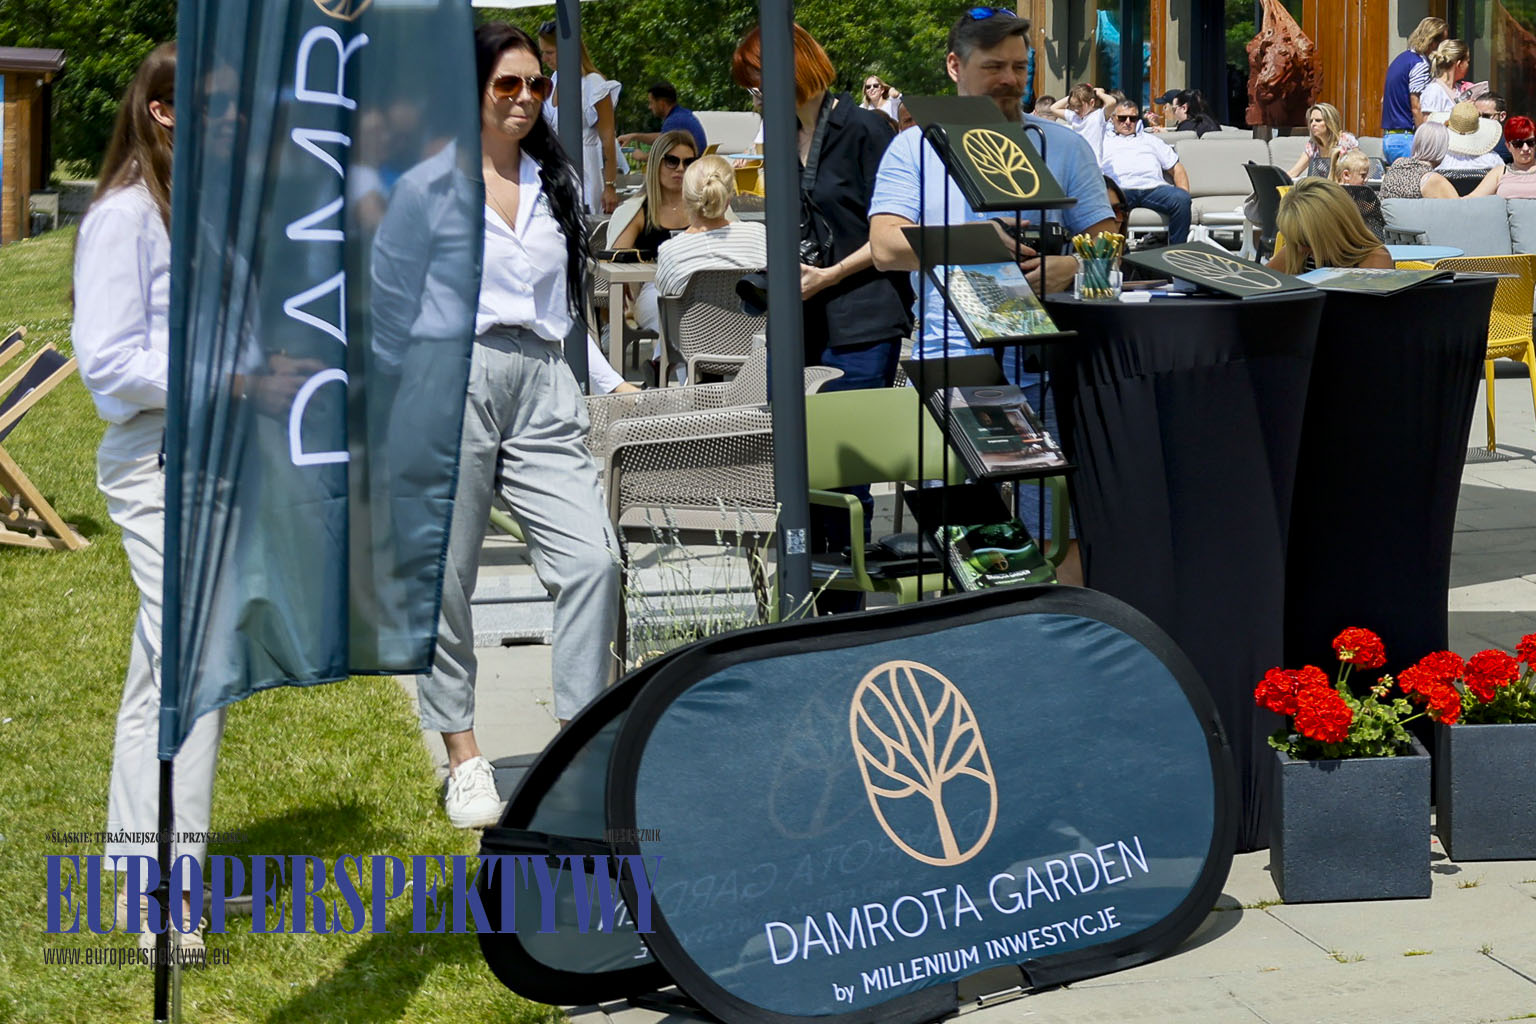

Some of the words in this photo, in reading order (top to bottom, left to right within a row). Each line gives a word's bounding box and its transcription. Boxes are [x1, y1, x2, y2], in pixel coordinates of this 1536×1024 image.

[765, 884, 982, 965] DAMROTA
[988, 835, 1150, 914] GARDEN
[832, 982, 855, 1004] by
[860, 946, 980, 994] MILLENIUM
[985, 906, 1121, 960] INWESTYCJE
